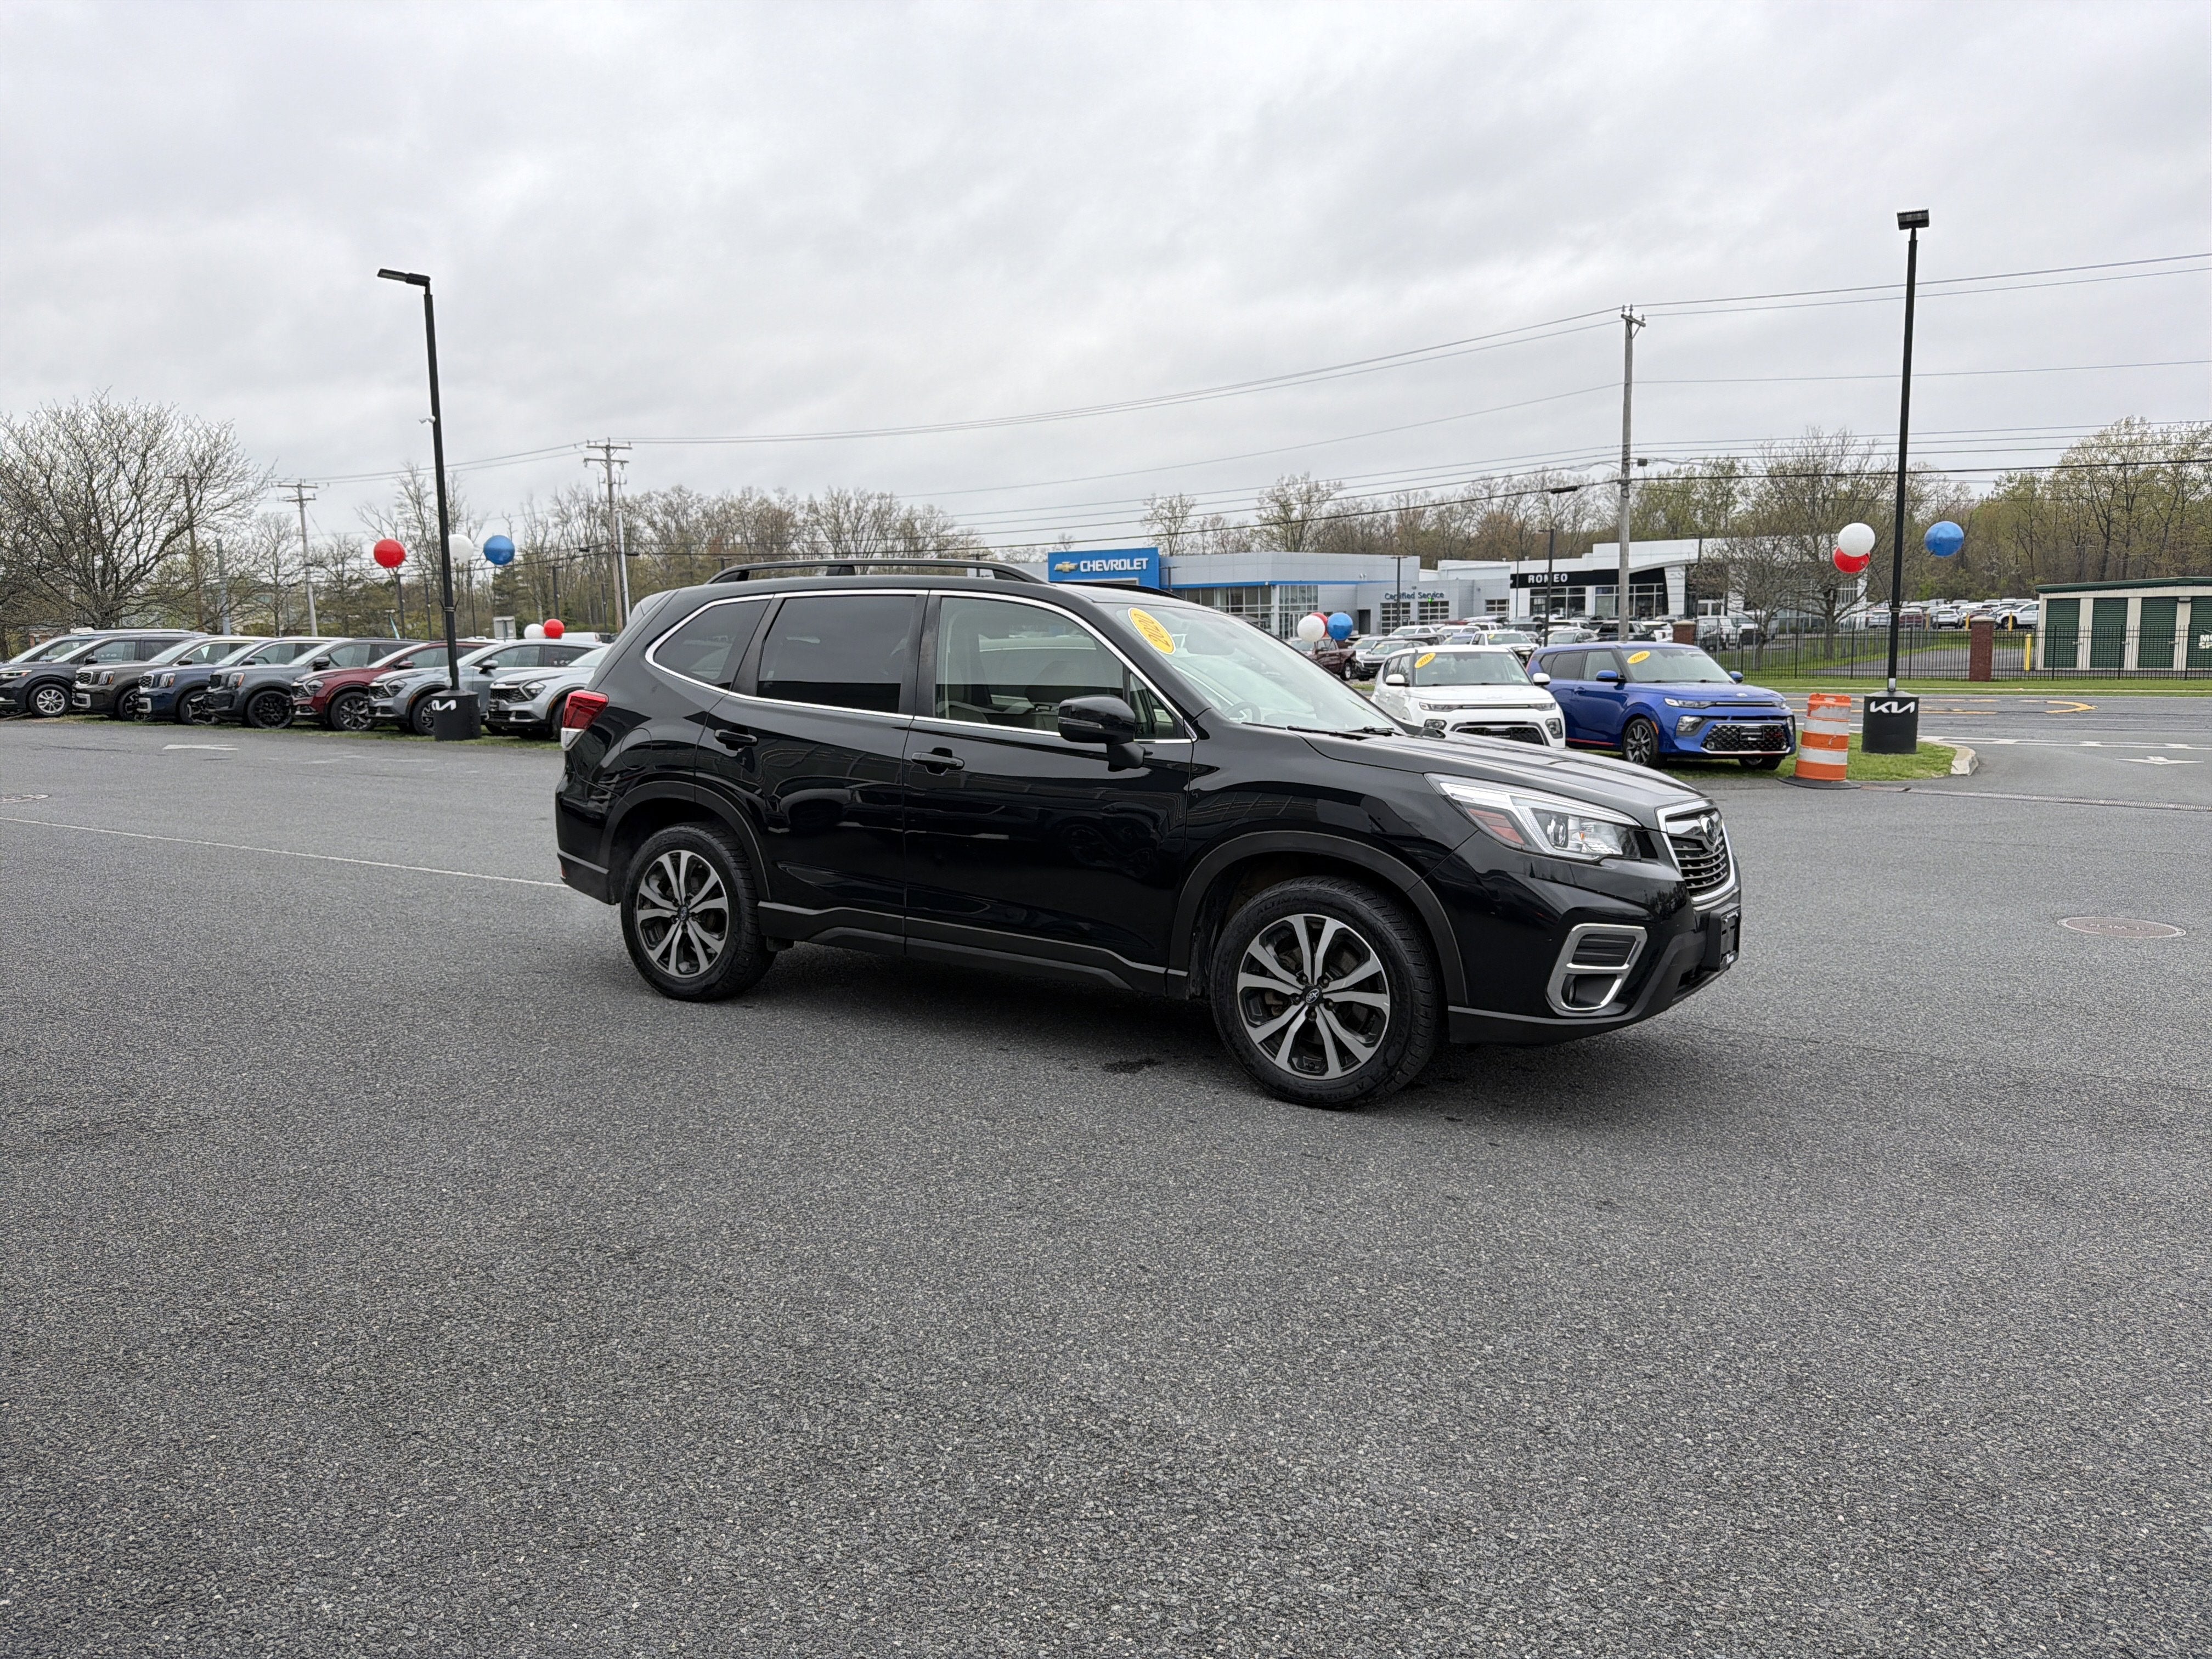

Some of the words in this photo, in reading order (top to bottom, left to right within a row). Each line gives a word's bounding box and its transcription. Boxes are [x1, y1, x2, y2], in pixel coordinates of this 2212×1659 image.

[1080, 558, 1148, 572] CHEVROLET
[1385, 591, 1415, 600] Cerified
[1133, 613, 1171, 647] 2020
[1870, 701, 1915, 713] KIA
